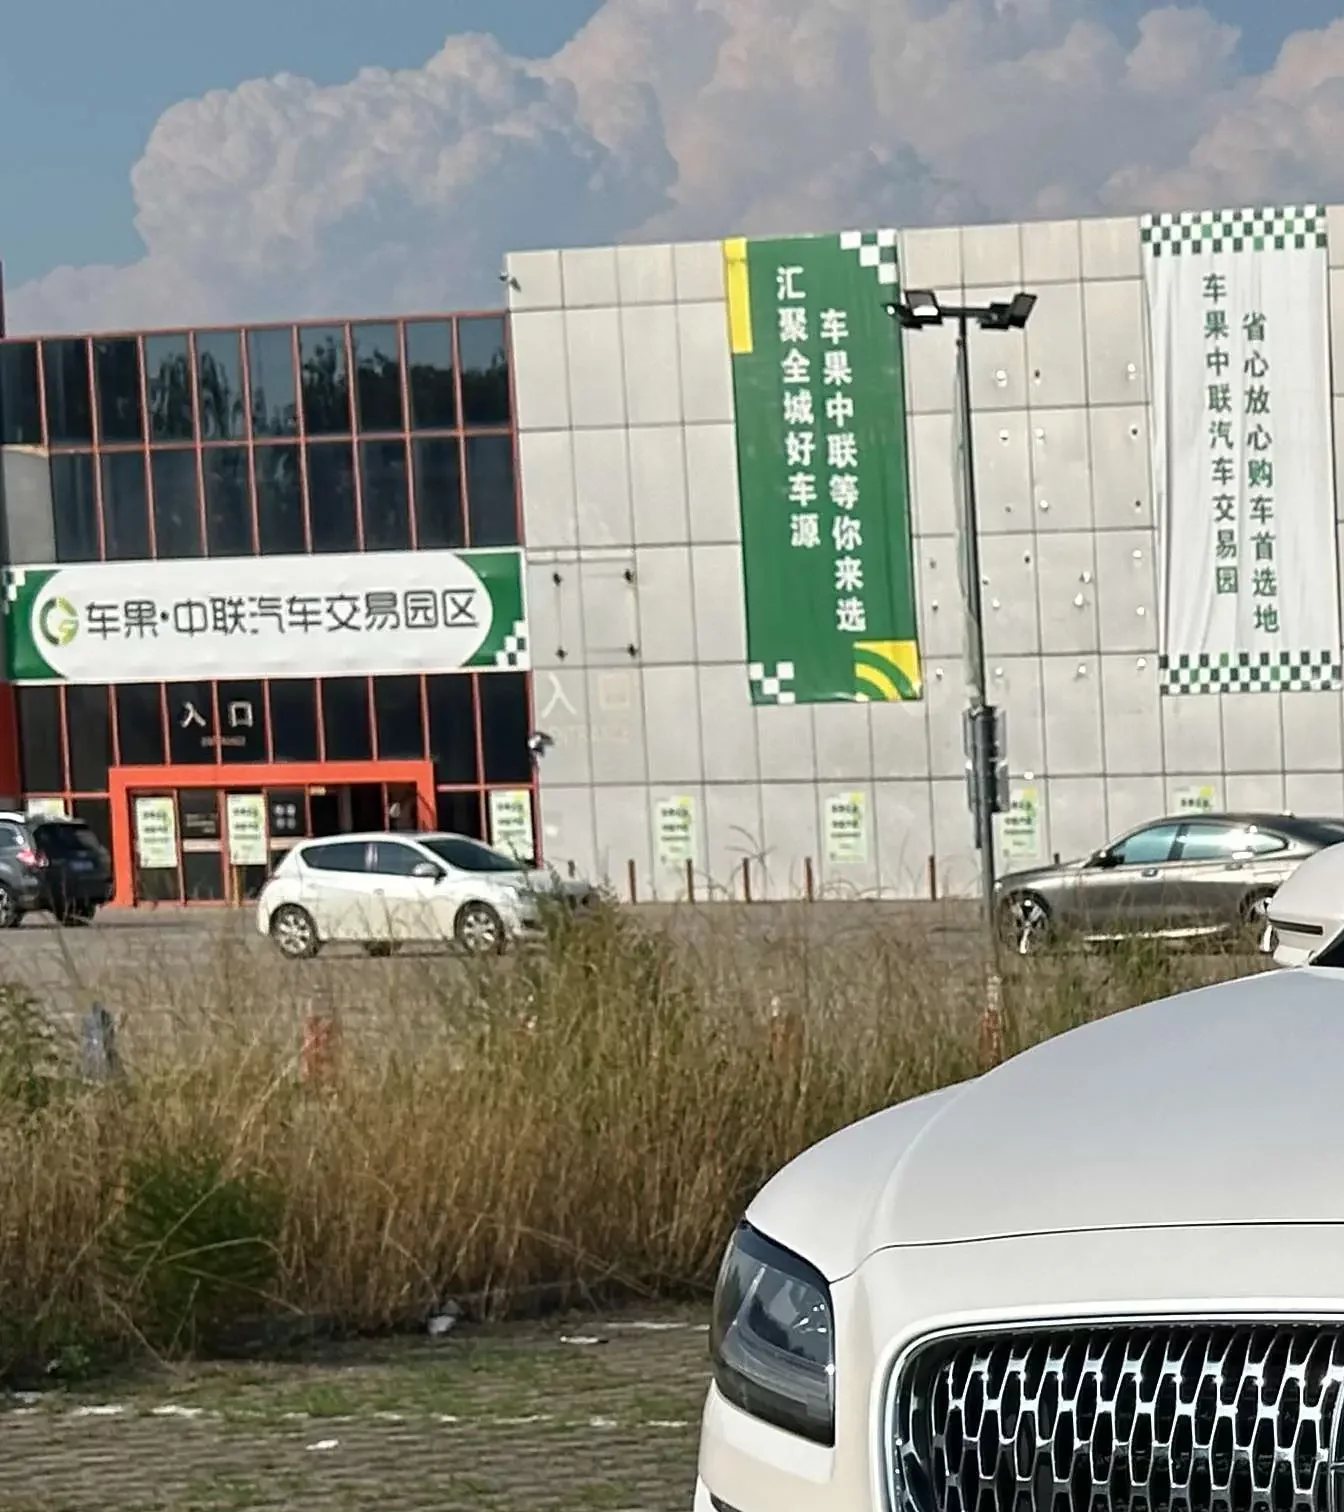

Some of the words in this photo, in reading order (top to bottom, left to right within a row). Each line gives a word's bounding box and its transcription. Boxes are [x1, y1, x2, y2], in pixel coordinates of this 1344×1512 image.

[776, 266, 821, 548] 汇聚全城好车源
[820, 308, 866, 632] 车果中联等你来选
[1202, 273, 1238, 594] 车果中联汽车交易园
[1242, 311, 1280, 633] 省心放心购车首选地
[181, 701, 253, 728] 入口
